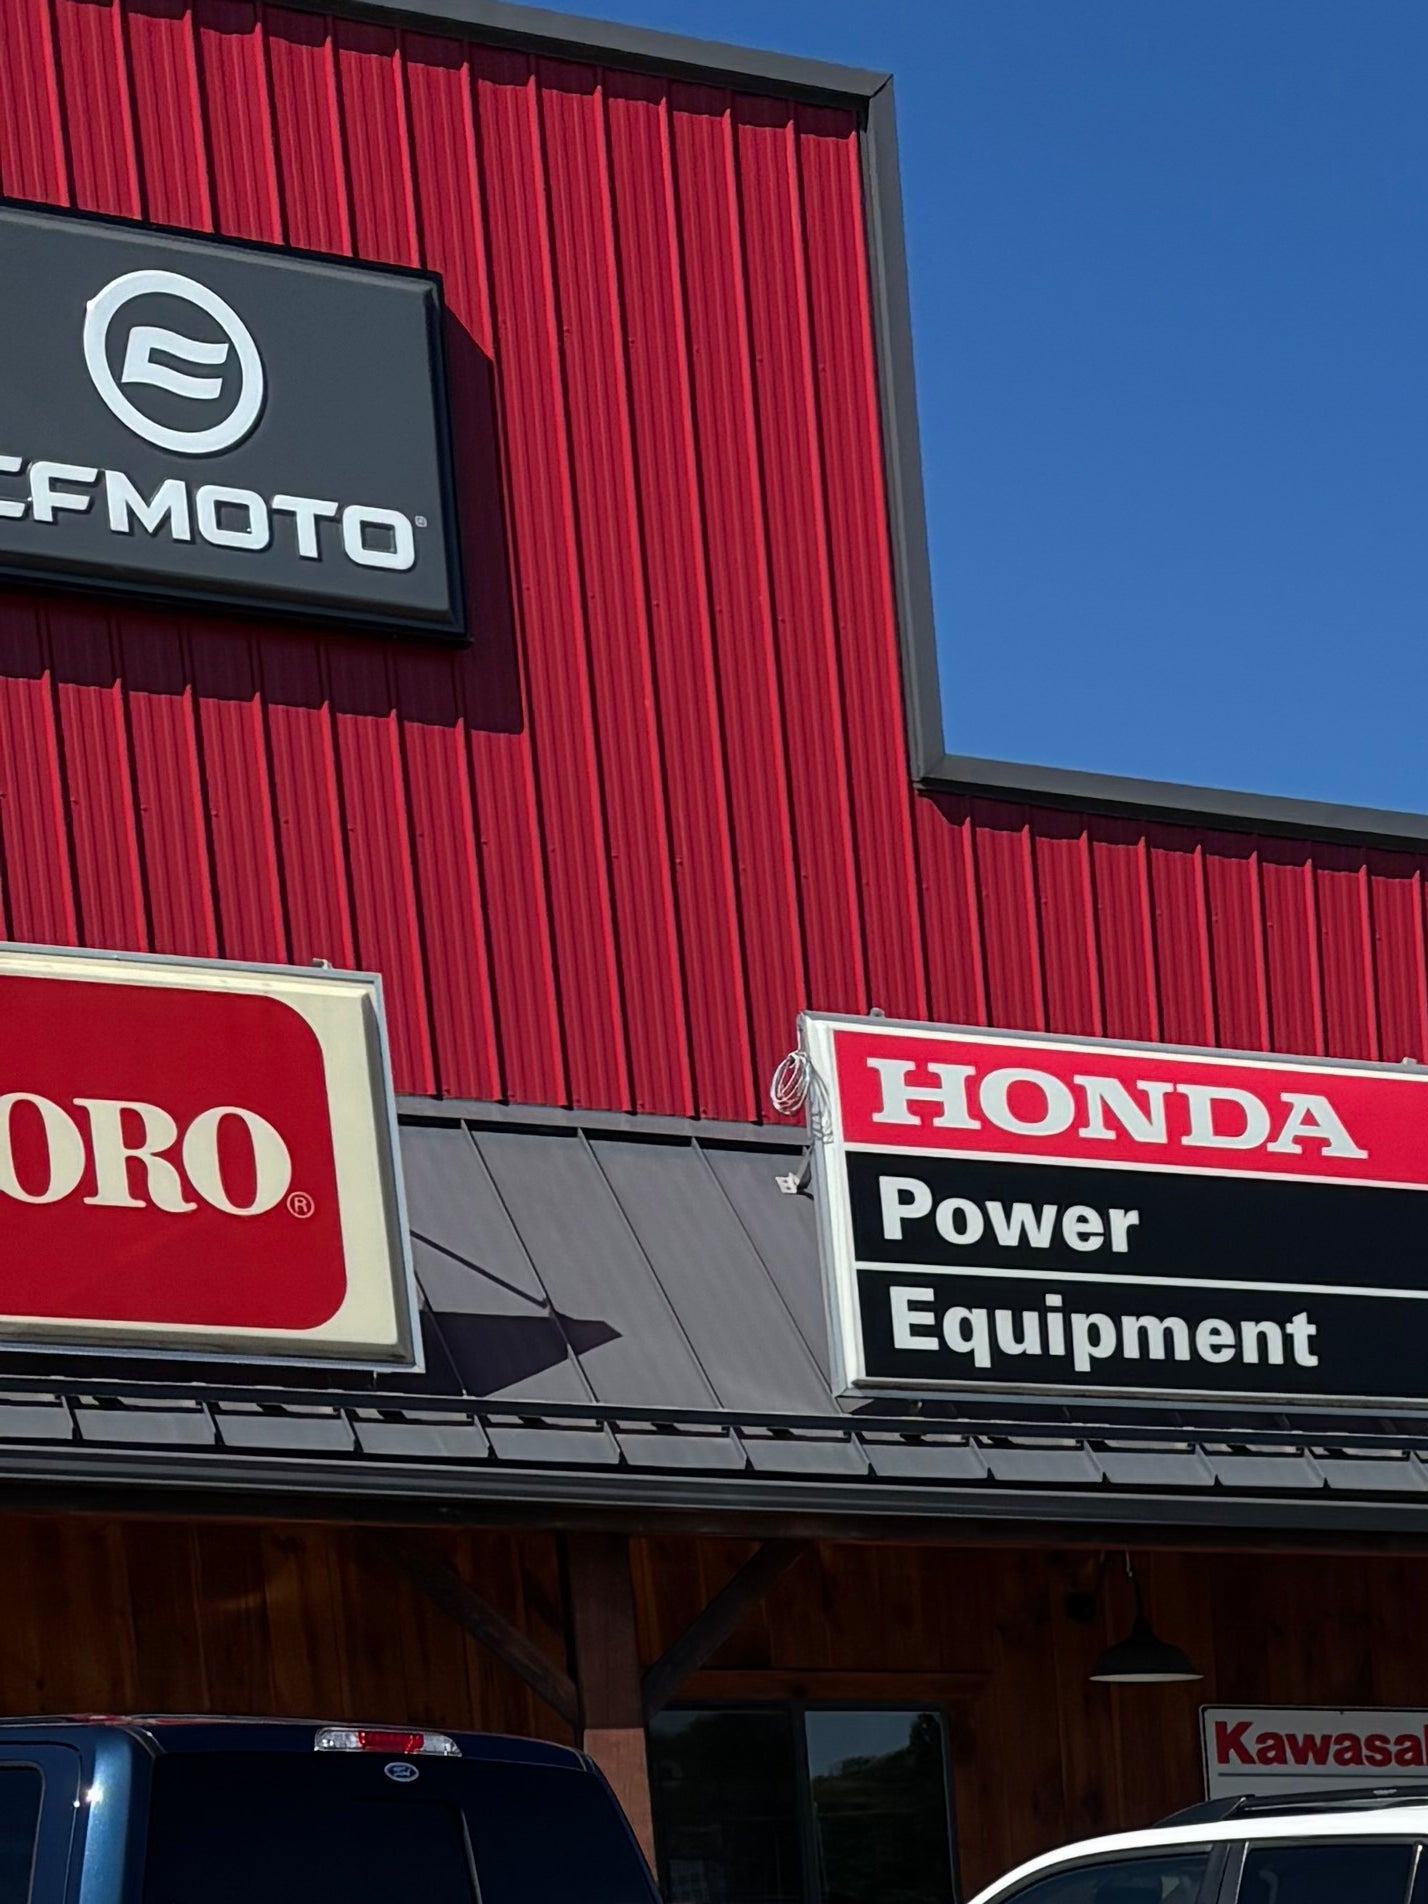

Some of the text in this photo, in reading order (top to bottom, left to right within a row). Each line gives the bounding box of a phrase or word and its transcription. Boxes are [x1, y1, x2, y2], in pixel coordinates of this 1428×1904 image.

[866, 1057, 1369, 1160] HONDA
[879, 1175, 1140, 1253] Power
[889, 1286, 1319, 1373] Equipment
